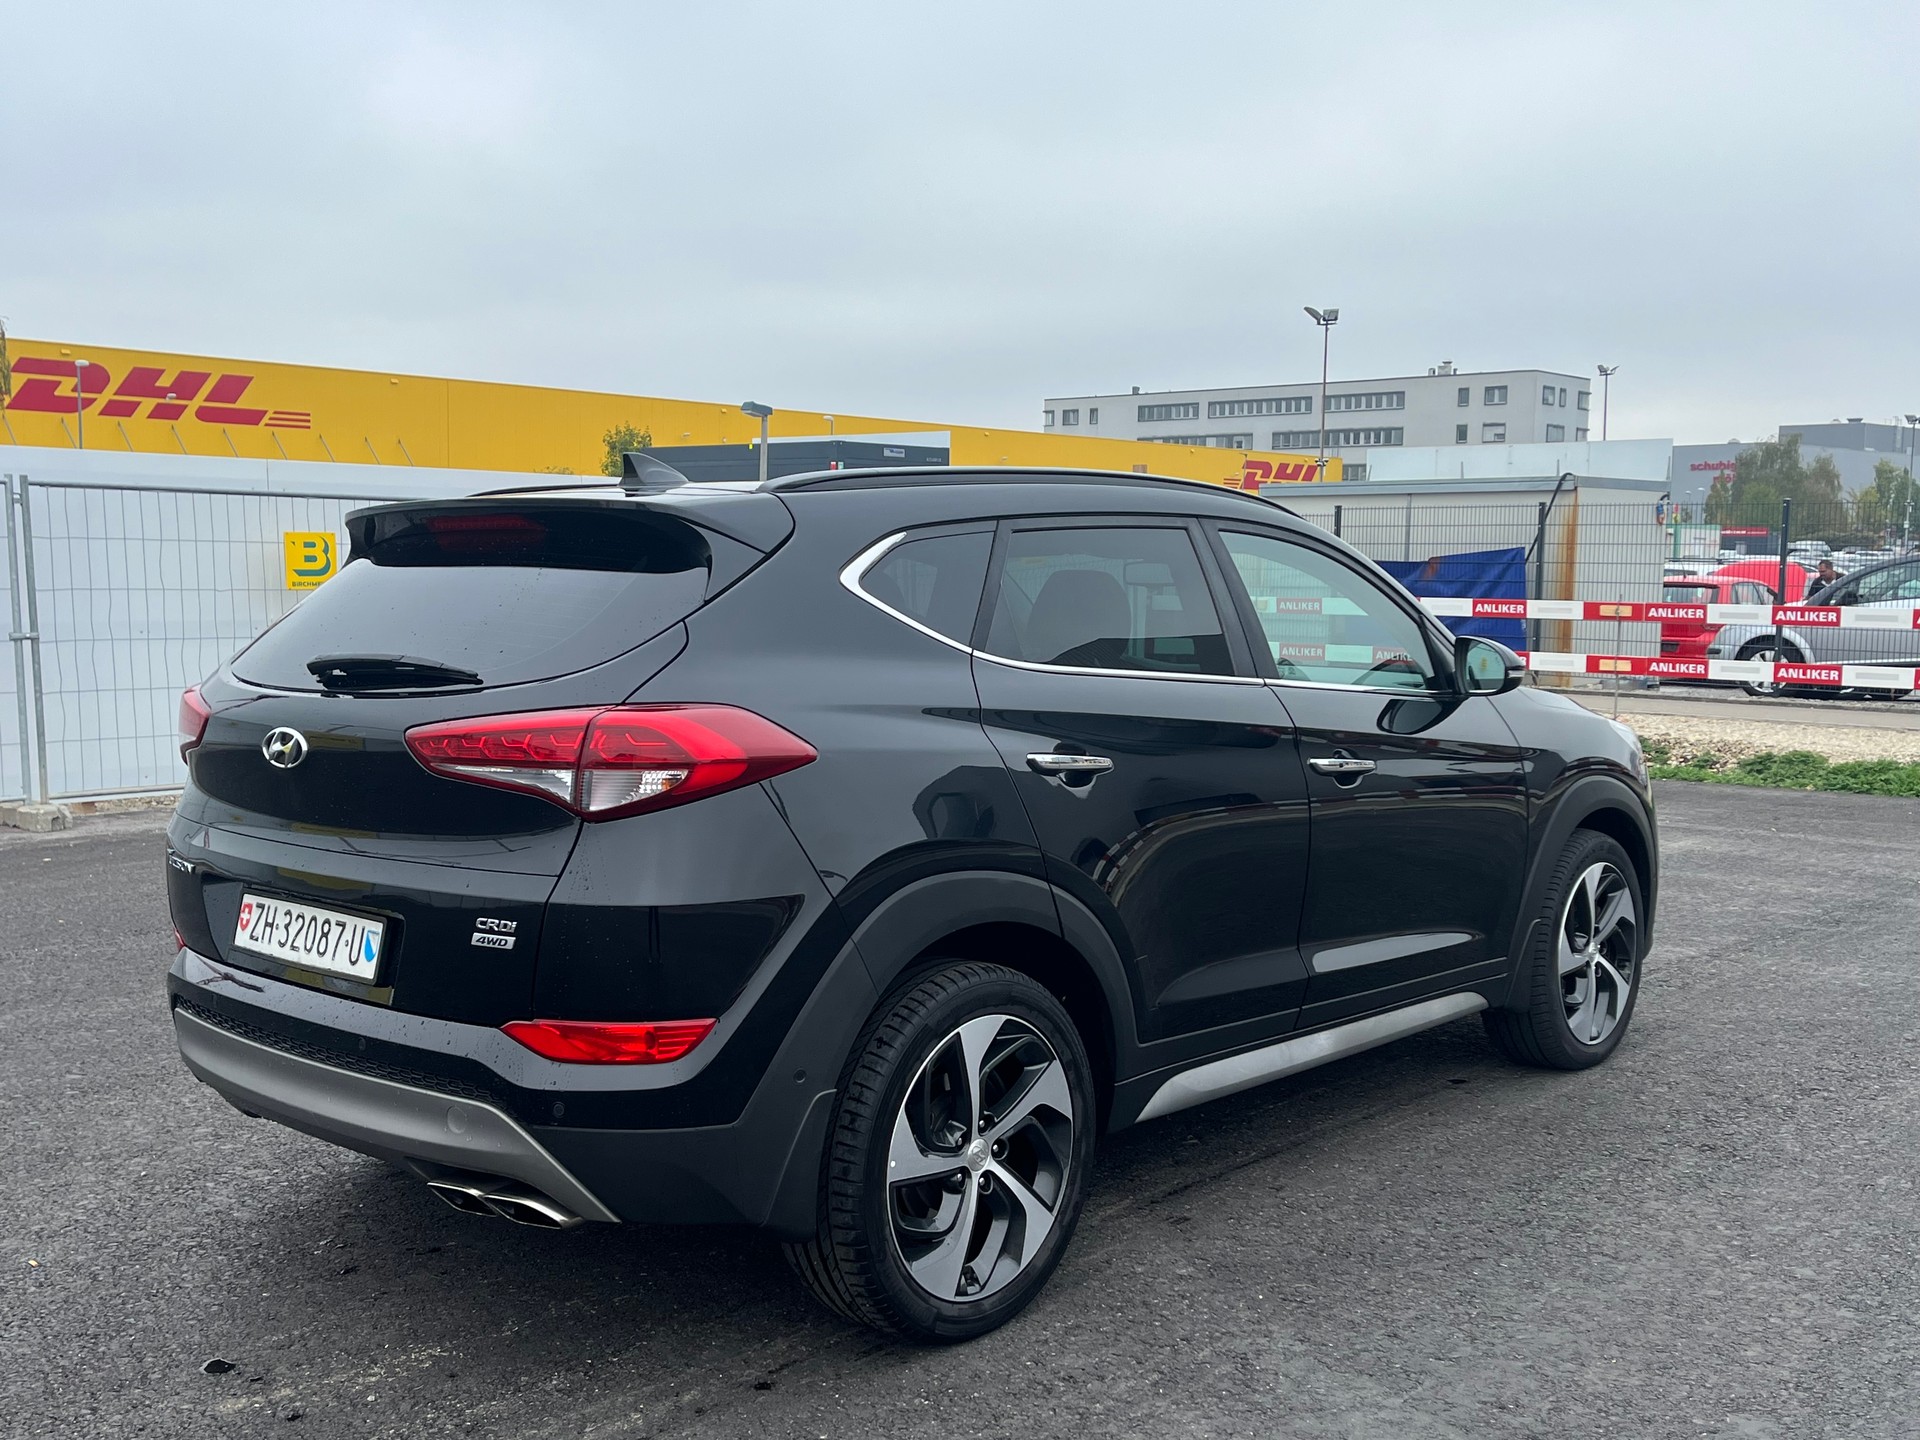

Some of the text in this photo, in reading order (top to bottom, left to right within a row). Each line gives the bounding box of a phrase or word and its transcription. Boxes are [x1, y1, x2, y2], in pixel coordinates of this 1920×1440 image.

[5, 356, 269, 426] DHL
[1689, 460, 1737, 472] schubig
[1279, 602, 1320, 611] ANLIKER
[1475, 603, 1525, 614] ANLIKER
[1648, 607, 1704, 619] ANLIKER
[1775, 610, 1837, 622] ANLIKER
[1281, 647, 1323, 657] ANLIKER
[1650, 661, 1705, 674] ANLIKER
[1777, 668, 1839, 681] ANLIKER
[475, 917, 518, 933] CRDi
[475, 936, 509, 947] 4WD
